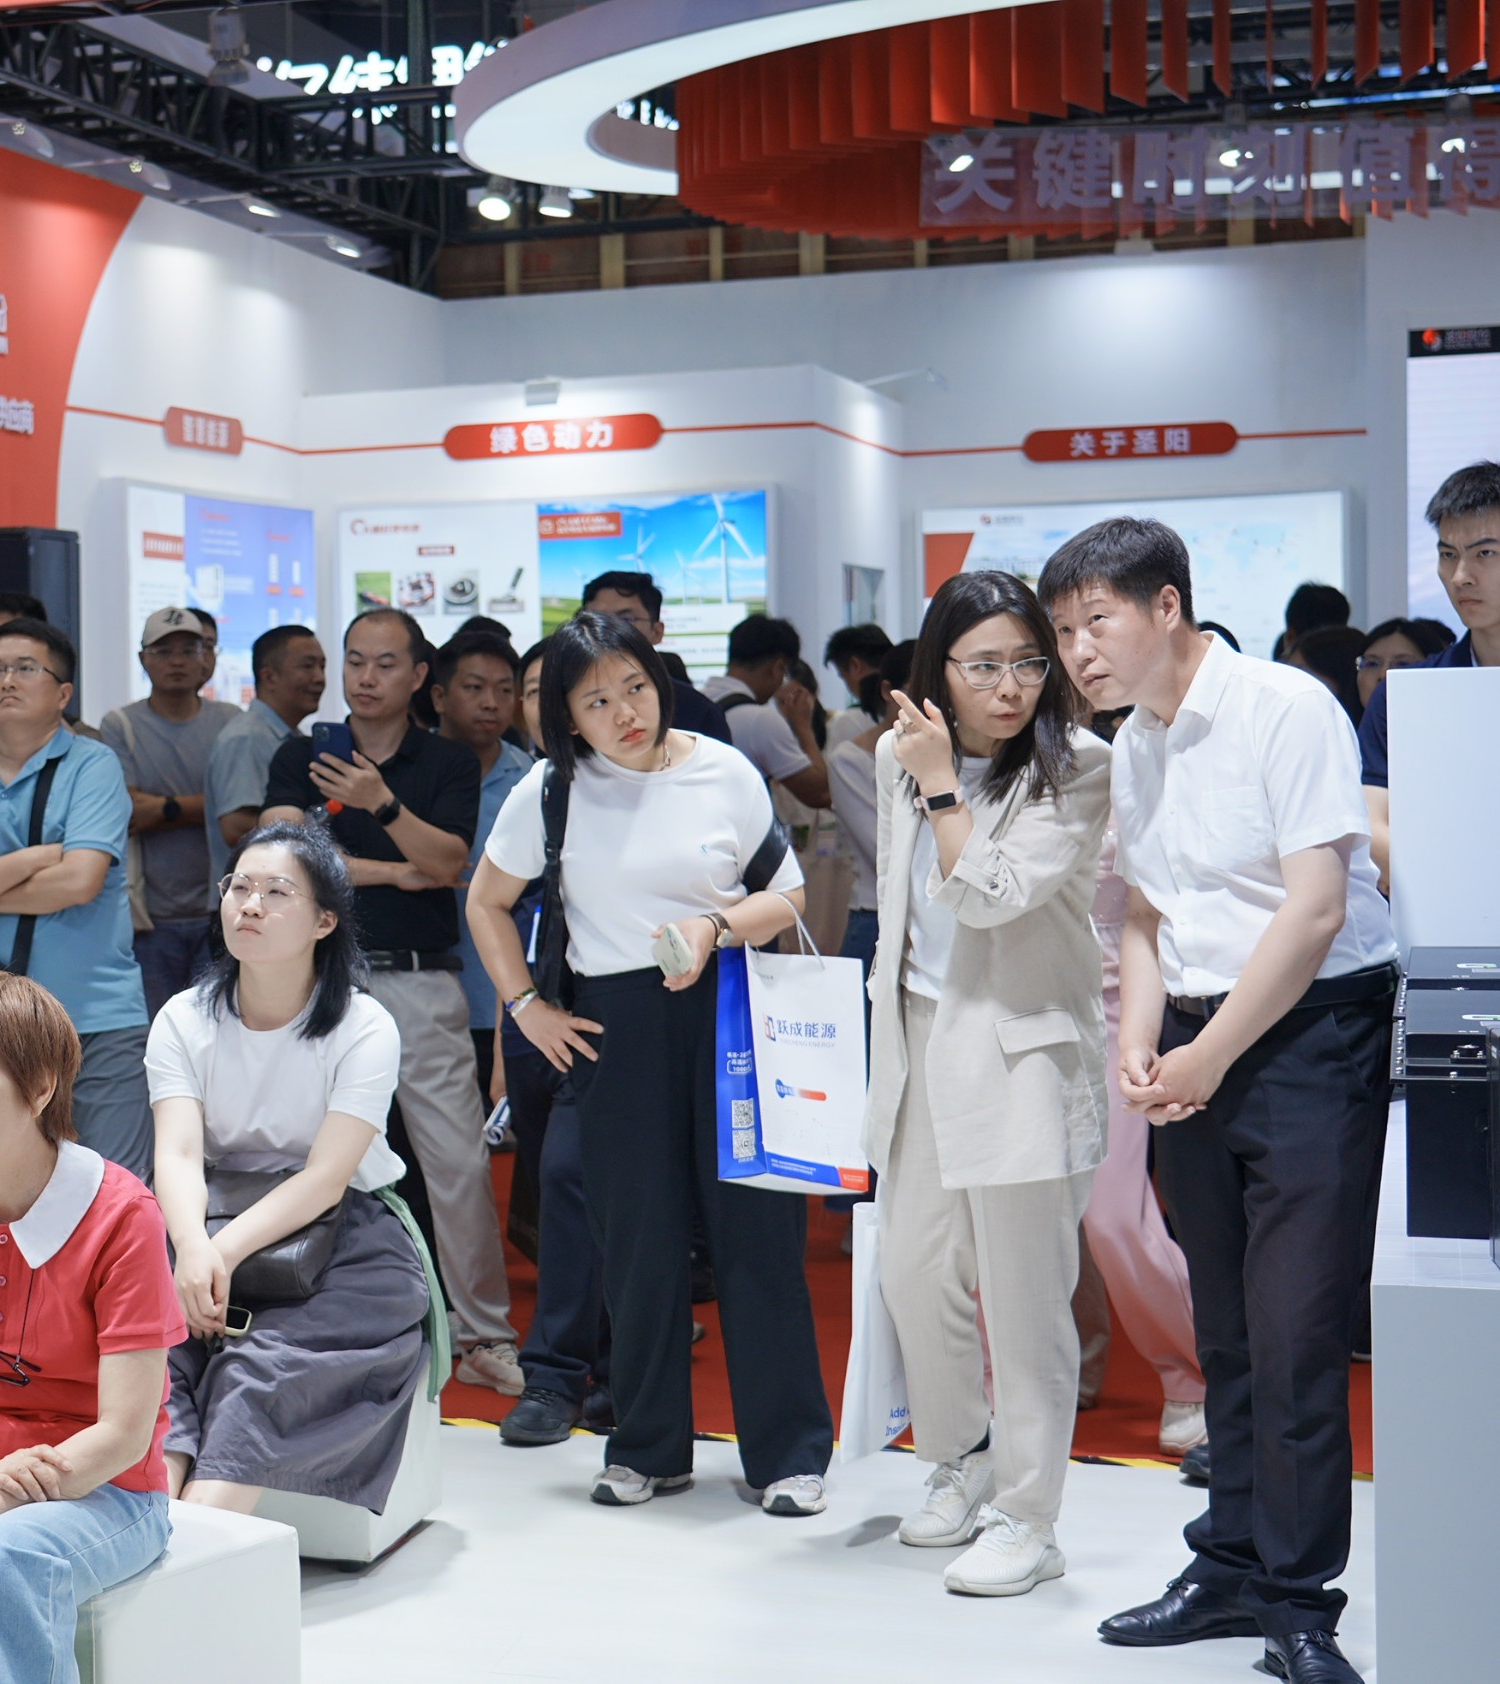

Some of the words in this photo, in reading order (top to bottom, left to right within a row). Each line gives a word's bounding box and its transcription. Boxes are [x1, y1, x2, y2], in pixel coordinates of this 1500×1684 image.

[490, 421, 614, 453] 绿色动力
[1070, 428, 1191, 457] 关于圣阳
[777, 1019, 836, 1039] 跃成能源
